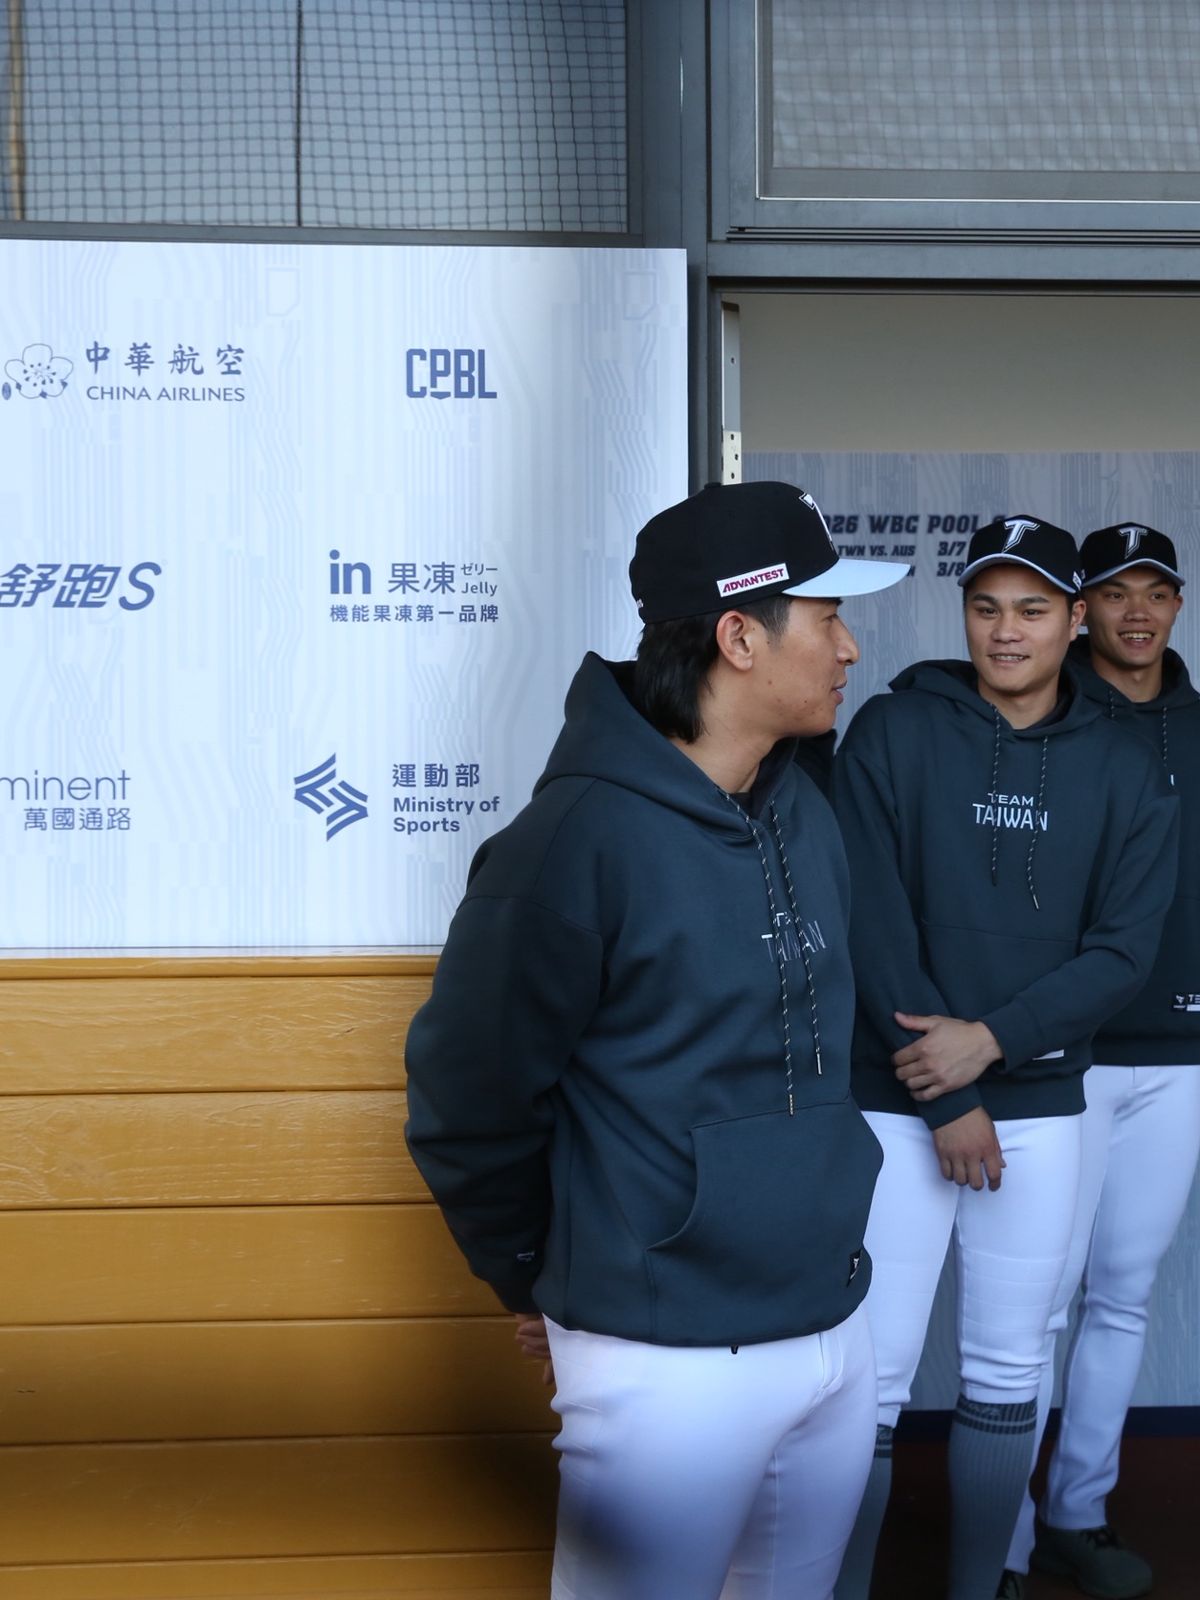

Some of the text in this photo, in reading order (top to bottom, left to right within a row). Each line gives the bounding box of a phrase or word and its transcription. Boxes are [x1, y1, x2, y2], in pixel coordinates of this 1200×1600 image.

[86, 341, 245, 376] 中華航空
[406, 348, 498, 399] CPBL
[86, 386, 245, 401] CHINA AIRLINES
[868, 514, 919, 534] WBC
[838, 541, 967, 557] TWN VS. AUS 3/7
[329, 549, 456, 595] in 果凍
[460, 562, 498, 576] ゼリー
[461, 582, 498, 597] Jelly
[722, 568, 785, 594] ADVANTEST
[329, 604, 499, 623] 機能果凍第一品牌
[392, 763, 480, 788] 運動部
[393, 796, 500, 815] Ministry of
[24, 807, 131, 831] 萬國通路
[393, 817, 460, 835] Sports
